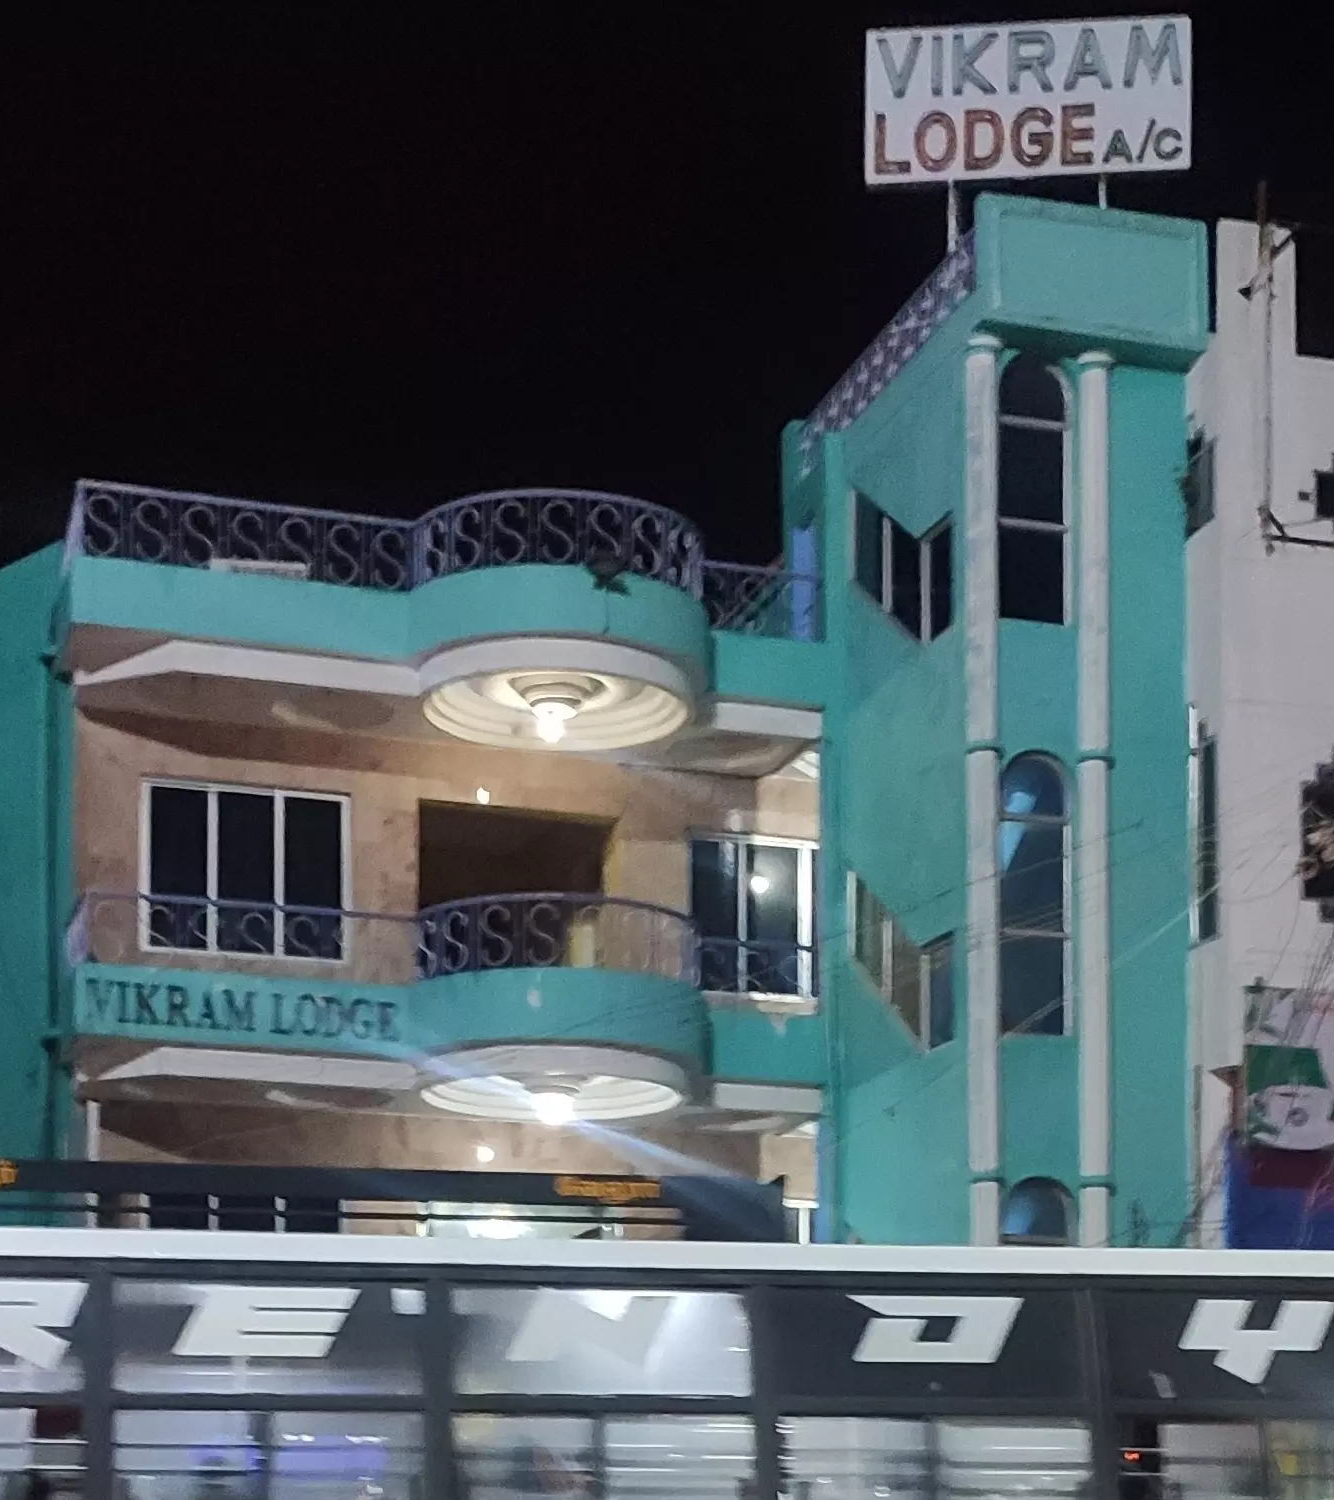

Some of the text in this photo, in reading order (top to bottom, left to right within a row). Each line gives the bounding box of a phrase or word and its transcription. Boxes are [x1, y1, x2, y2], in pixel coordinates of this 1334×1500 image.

[875, 23, 1184, 99] VIKRAM
[873, 102, 1184, 175] LODGE A/C
[83, 976, 401, 1042] VIKRAM LODGE
